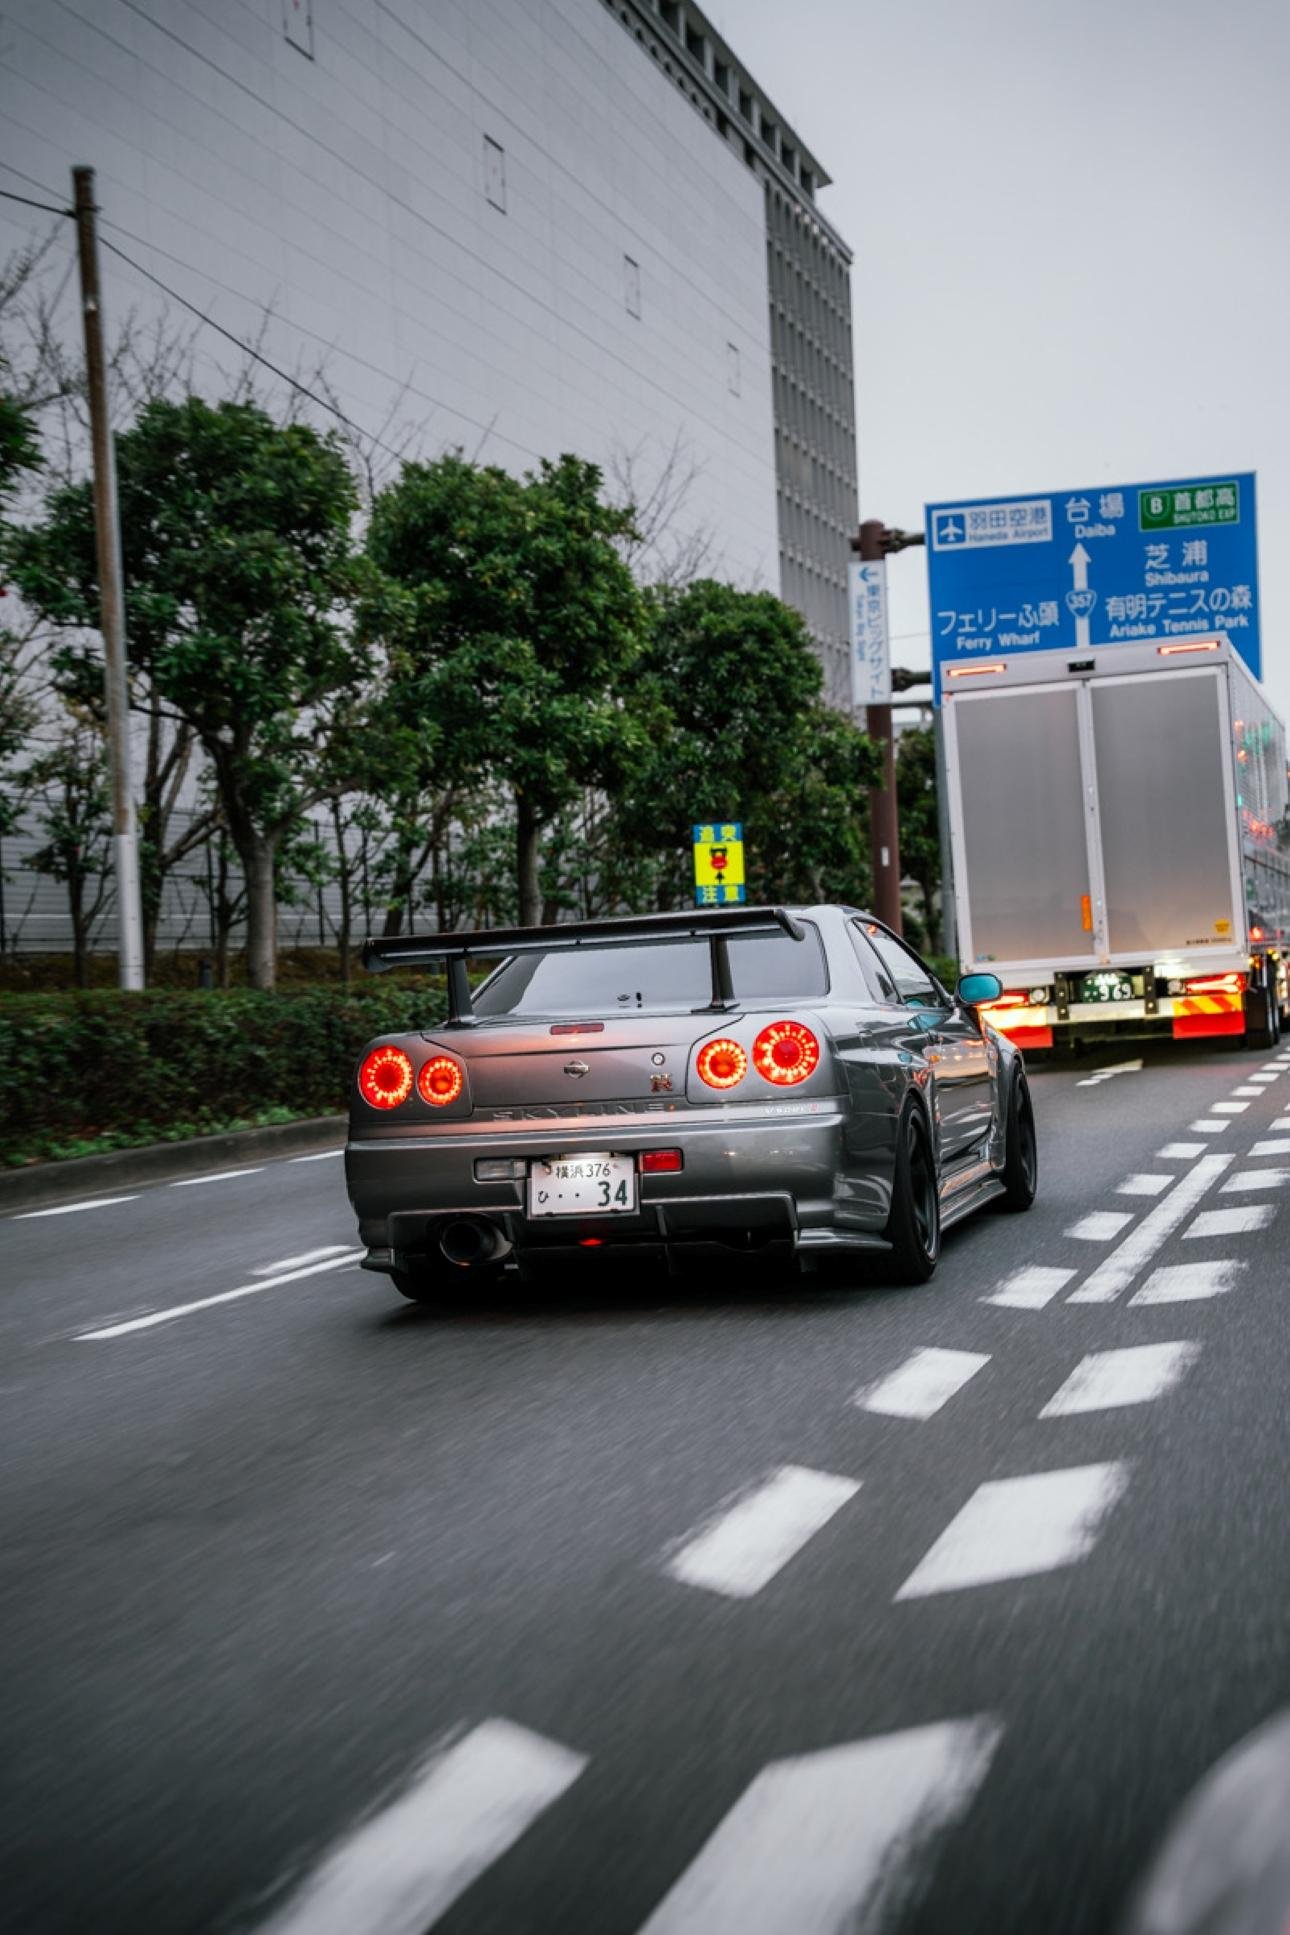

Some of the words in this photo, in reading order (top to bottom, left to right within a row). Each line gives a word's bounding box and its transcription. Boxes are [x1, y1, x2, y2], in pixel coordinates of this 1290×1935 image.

[1065, 492, 1125, 523] 台場
[1150, 498, 1164, 515] B
[1012, 525, 1050, 540] Airport
[1075, 523, 1116, 539] Daiba
[1144, 539, 1208, 570] 芝浦
[1145, 569, 1210, 588] Shibaura
[1105, 584, 1253, 622] 有明テニスの森
[937, 600, 1060, 636] フェリーふ頭
[1109, 622, 1156, 640] Ariake
[1164, 616, 1209, 635] Tennis
[1214, 613, 1249, 631] Park
[956, 635, 992, 652] Ferry
[999, 630, 1040, 648] Wharf
[493, 1101, 665, 1121] SKYLINE
[586, 1162, 612, 1178] 376
[537, 1190, 549, 1204] ひ
